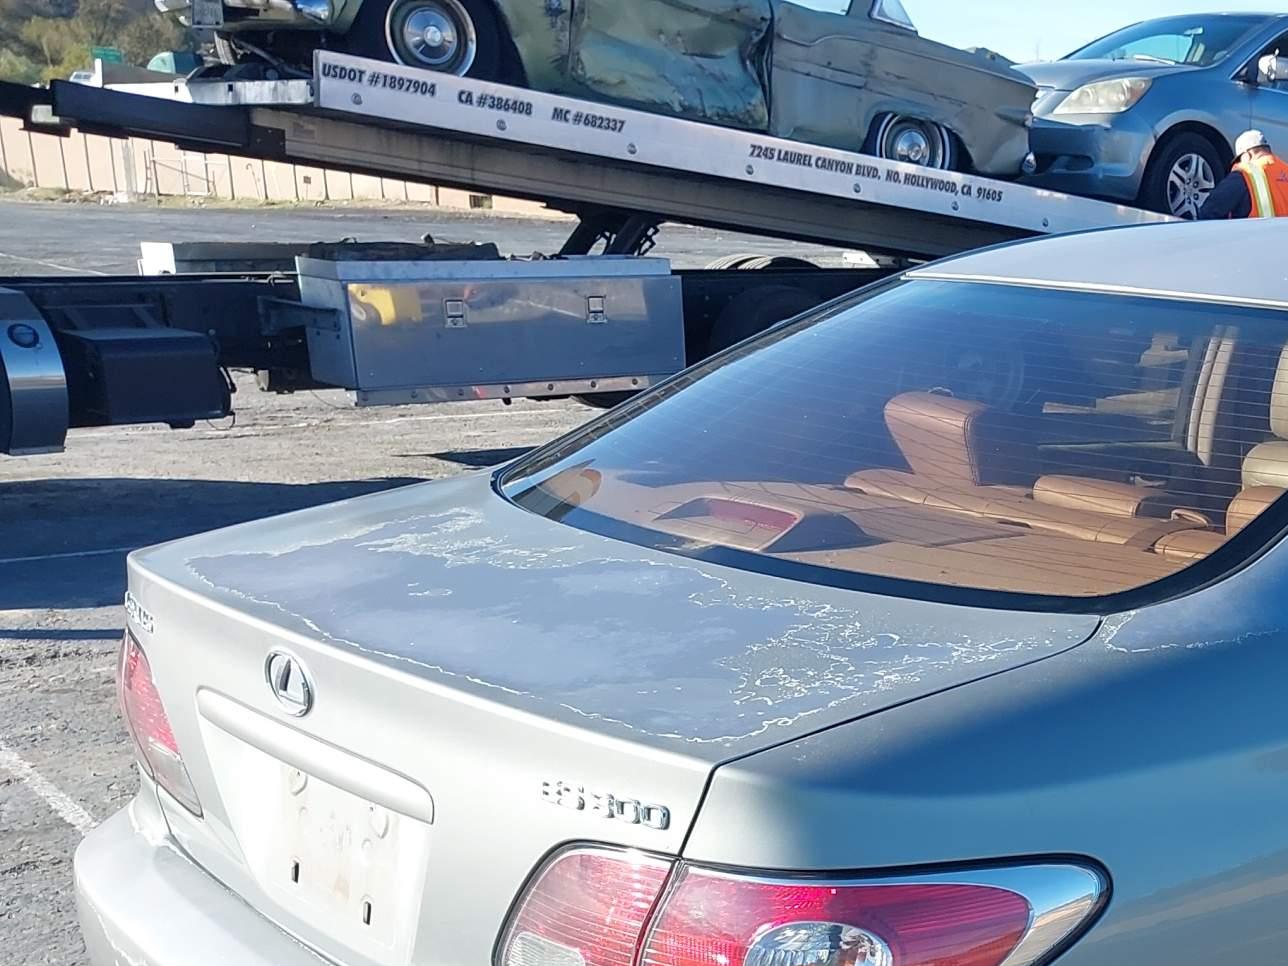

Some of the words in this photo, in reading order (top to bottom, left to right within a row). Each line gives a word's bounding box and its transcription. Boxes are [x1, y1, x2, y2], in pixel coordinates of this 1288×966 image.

[321, 63, 365, 84] USDOT
[367, 70, 437, 97] #1897904
[457, 90, 474, 106] CA
[476, 93, 533, 116] #386408
[552, 107, 571, 124] MC
[572, 110, 625, 133] #682337
[749, 144, 776, 160] 7245
[776, 149, 813, 168] LAUREL
[815, 156, 853, 175] CANYON
[855, 164, 881, 180] BLVD.
[885, 170, 902, 184] NO.
[903, 173, 959, 196] HOLLYWOOD,
[960, 184, 972, 198] CA
[976, 186, 1003, 202] 91605
